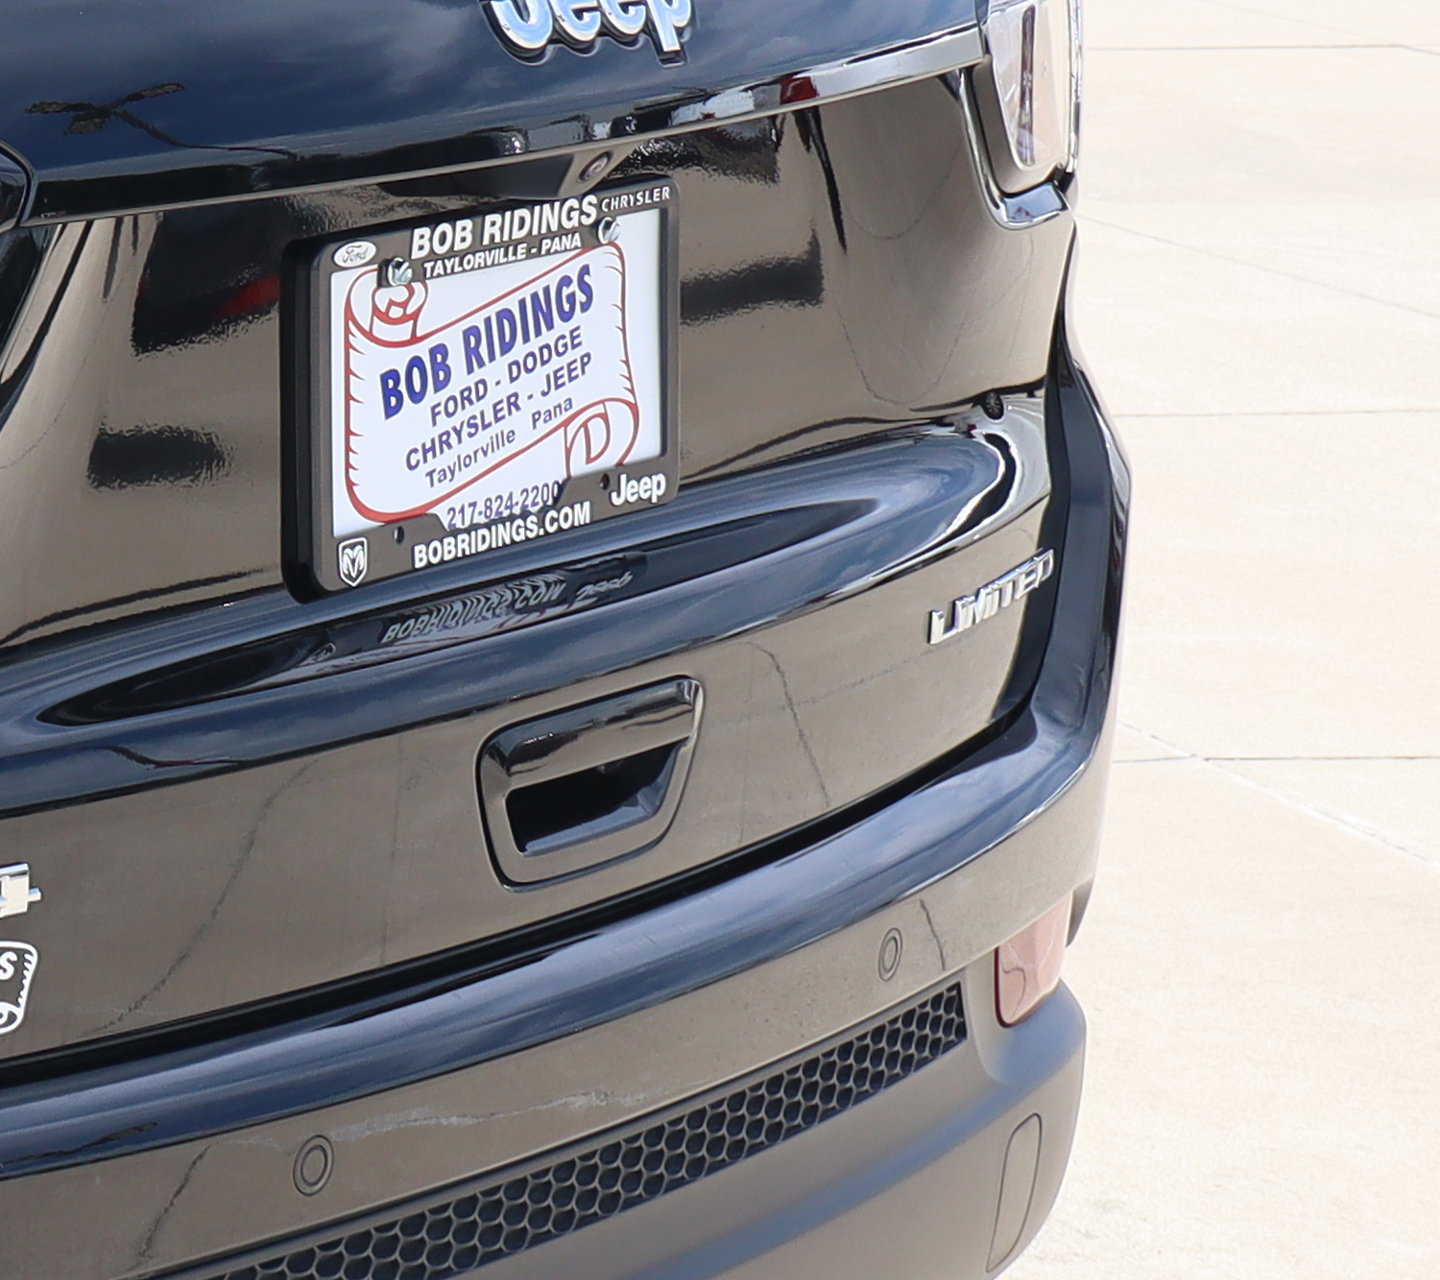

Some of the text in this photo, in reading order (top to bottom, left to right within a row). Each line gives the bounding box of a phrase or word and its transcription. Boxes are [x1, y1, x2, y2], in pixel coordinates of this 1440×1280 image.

[410, 194, 598, 261] BOB RIDINGS
[601, 186, 671, 213] CHRYSLER
[423, 243, 527, 279] TAYLORVILLE
[541, 232, 582, 256] PANA
[379, 263, 595, 420] BOB RIDINGS
[429, 377, 489, 427] FORD
[508, 326, 584, 384] DODGE
[405, 389, 522, 472] CHRYSLER
[539, 352, 592, 398] JEEP
[425, 396, 574, 489] Taylorville Pana
[446, 480, 562, 532] 217-824-2200
[610, 472, 667, 508] Jeep
[413, 501, 591, 569] BOBRIDINGS.COM
[929, 549, 1054, 644] LIMITED
